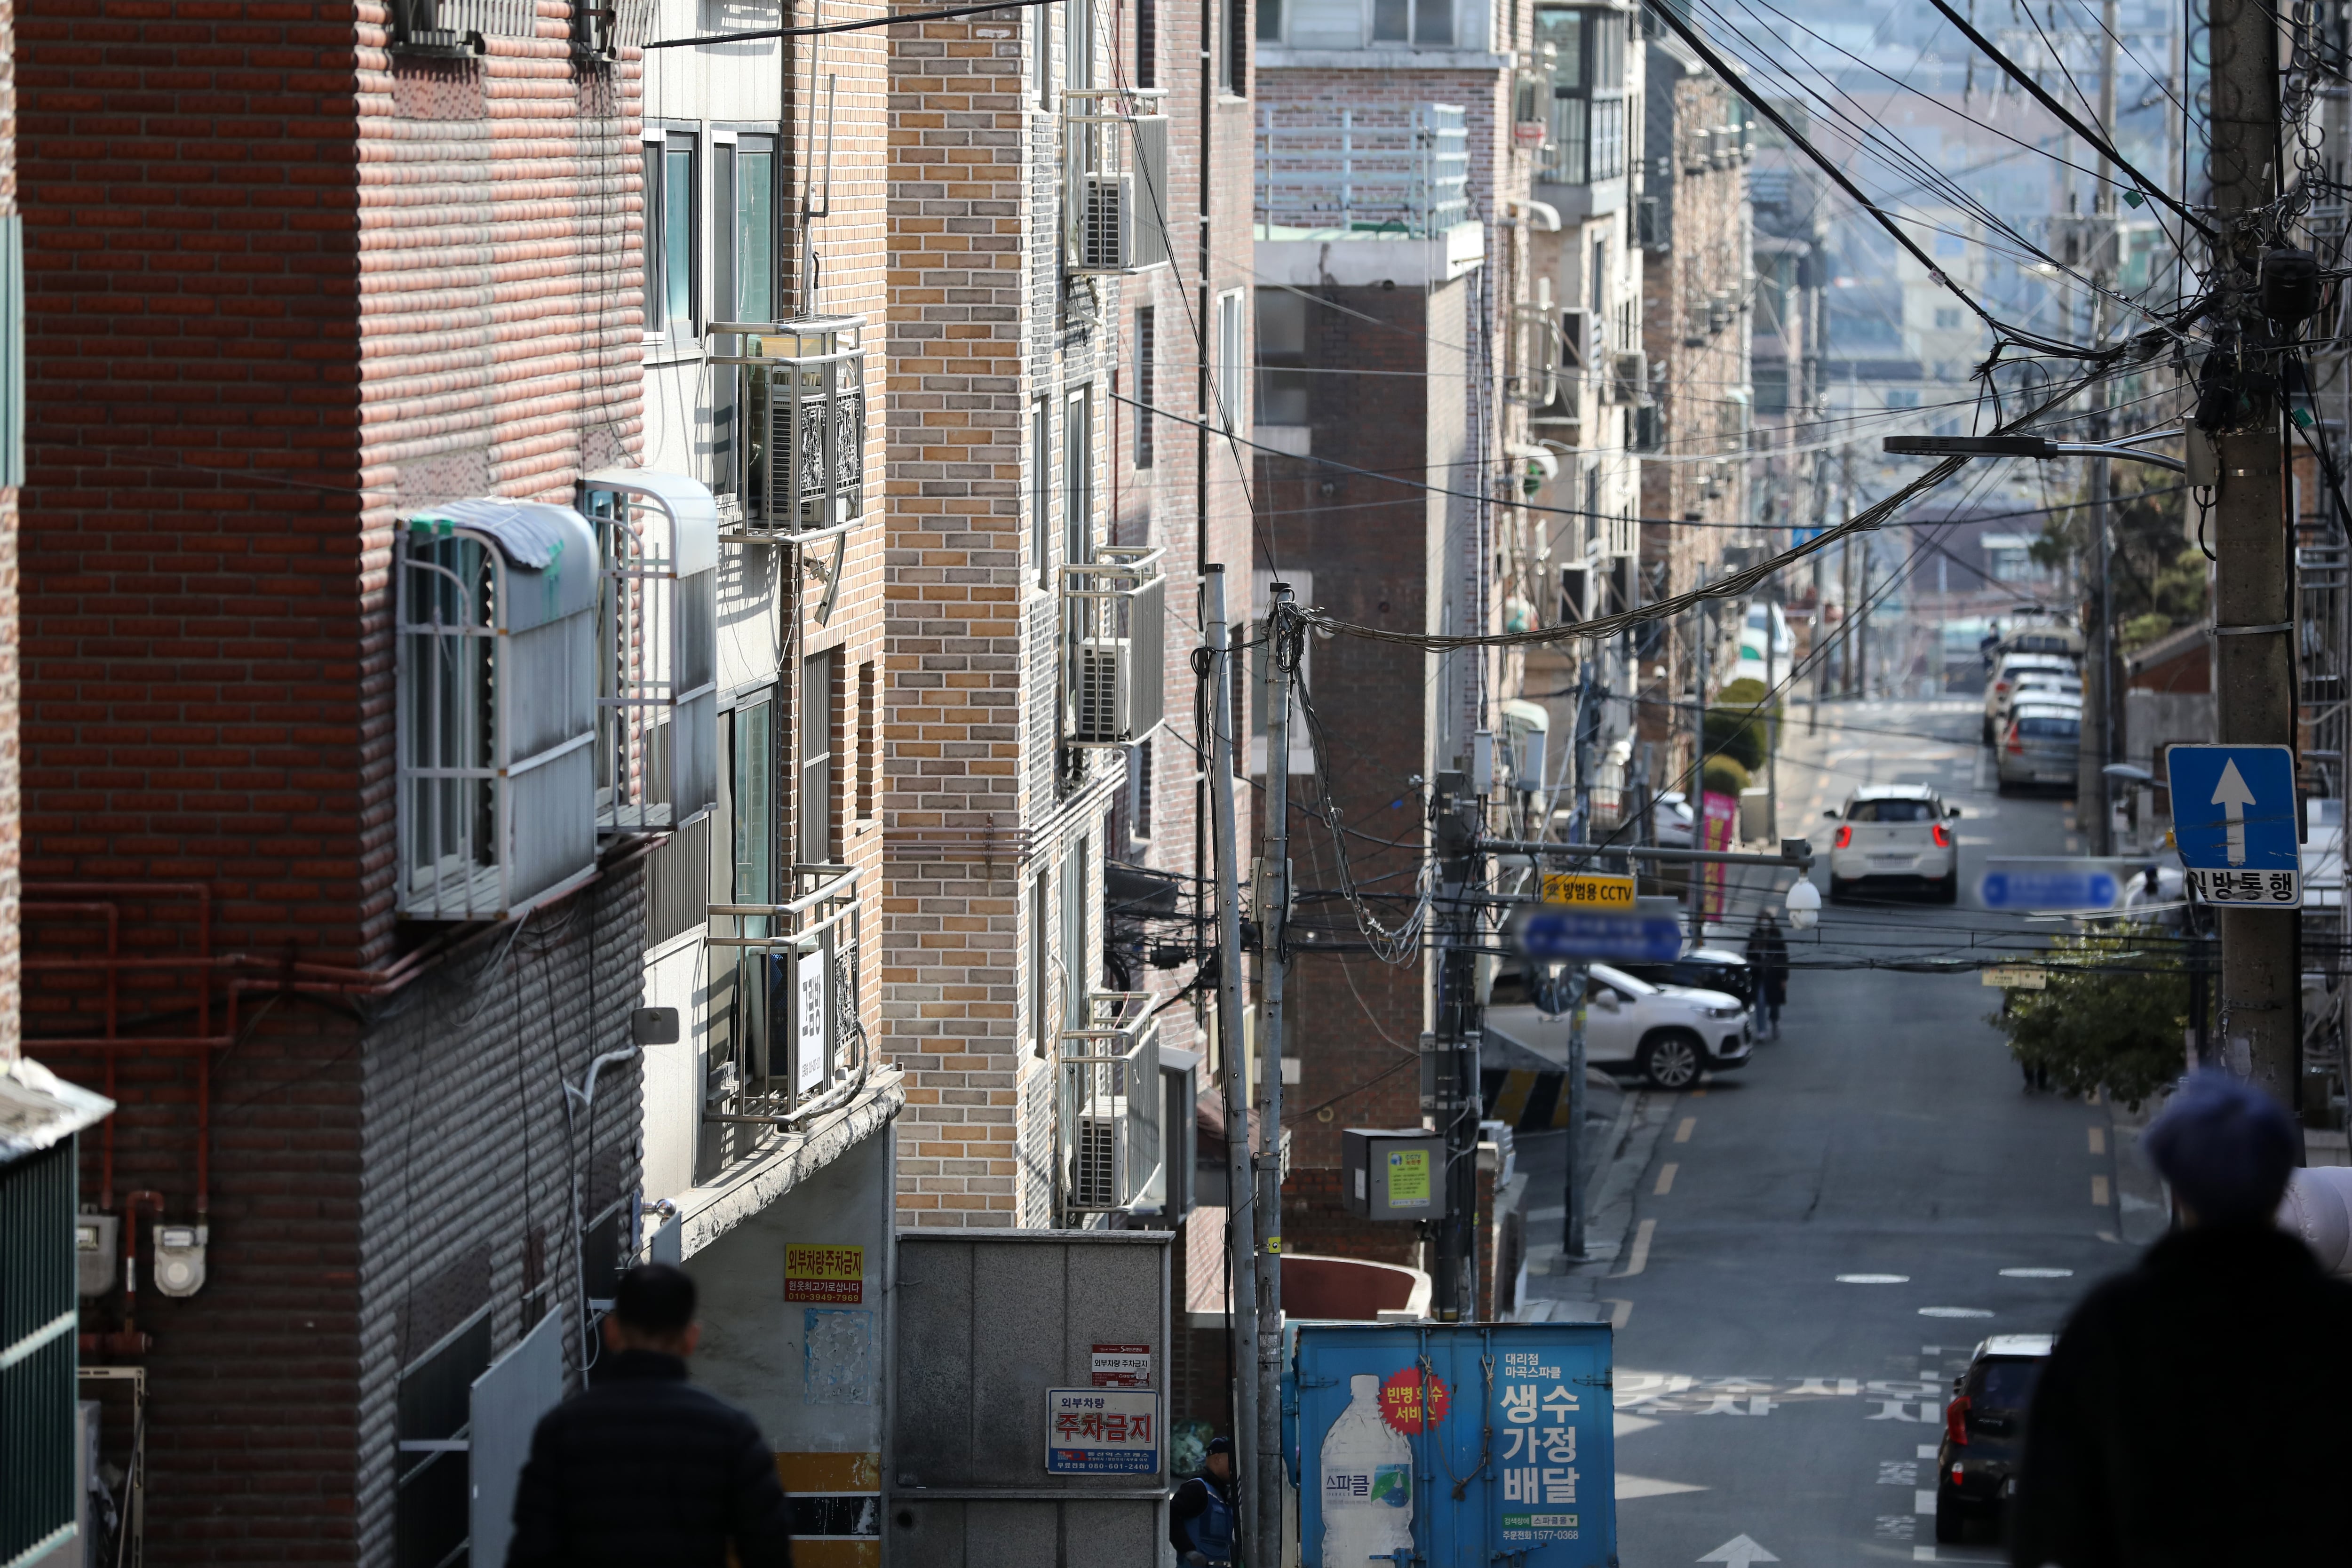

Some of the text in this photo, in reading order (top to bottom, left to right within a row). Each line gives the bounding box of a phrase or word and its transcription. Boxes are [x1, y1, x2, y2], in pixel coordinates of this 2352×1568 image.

[1563, 883, 1632, 901] 방범용 CCTV
[2189, 871, 2292, 901] 일방통행
[788, 1293, 859, 1302] 010-3949-7969
[1505, 1353, 1539, 1365] 대리점
[1505, 1366, 1561, 1379] 마곡스파클
[1061, 1398, 1105, 1409] 외부차량
[1387, 1387, 1413, 1404] 빈병
[1500, 1385, 1580, 1424] 생수
[1395, 1406, 1436, 1423] 서비스
[1056, 1412, 1152, 1443] 주차금지
[1502, 1426, 1577, 1464] 가정
[1326, 1475, 1370, 1496] 스파클
[1503, 1467, 1580, 1504] 배달
[1534, 1516, 1567, 1525] 스파클몰
[1503, 1530, 1579, 1540] 주문전화 1577-0368
